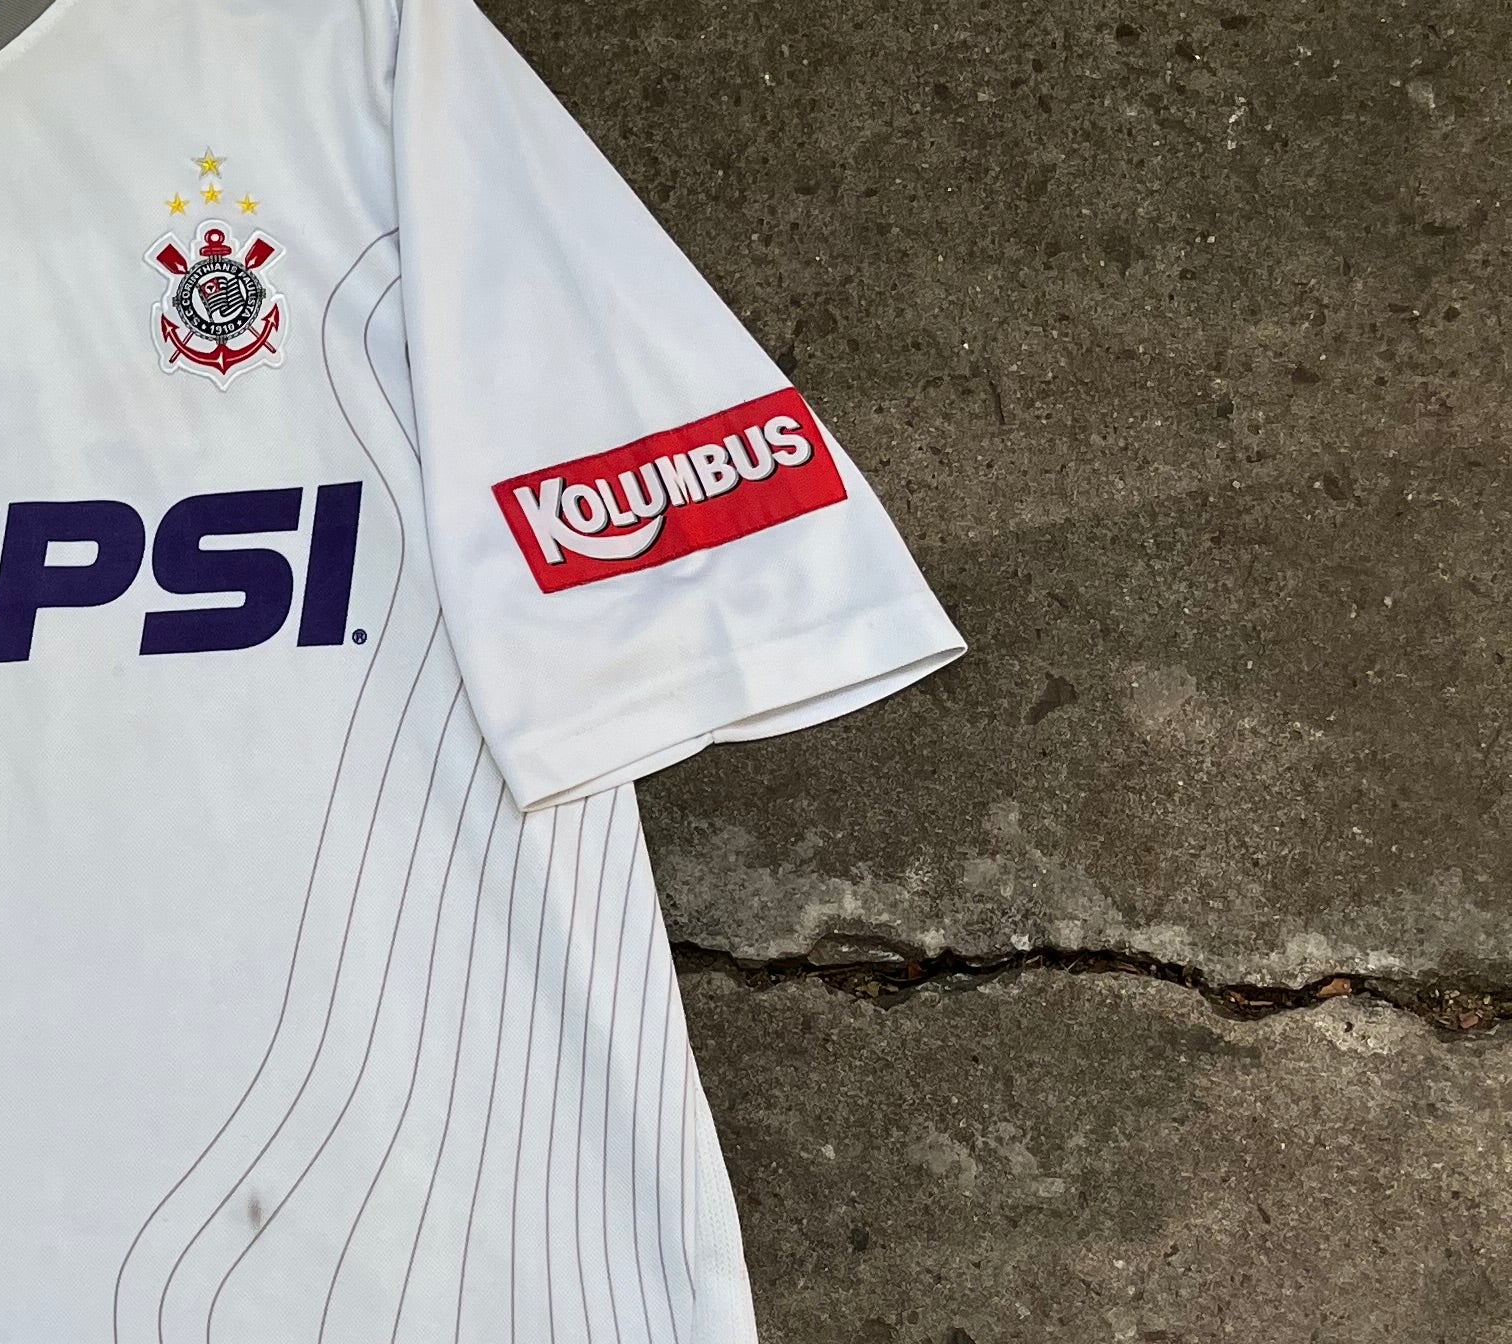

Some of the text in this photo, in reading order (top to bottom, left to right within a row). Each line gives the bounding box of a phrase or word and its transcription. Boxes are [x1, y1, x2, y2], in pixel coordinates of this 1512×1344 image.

[181, 262, 238, 306] CORINTHIANS
[238, 271, 256, 318] PAULISTA
[209, 323, 235, 335] 1910
[512, 415, 814, 565] KOLUMBUS
